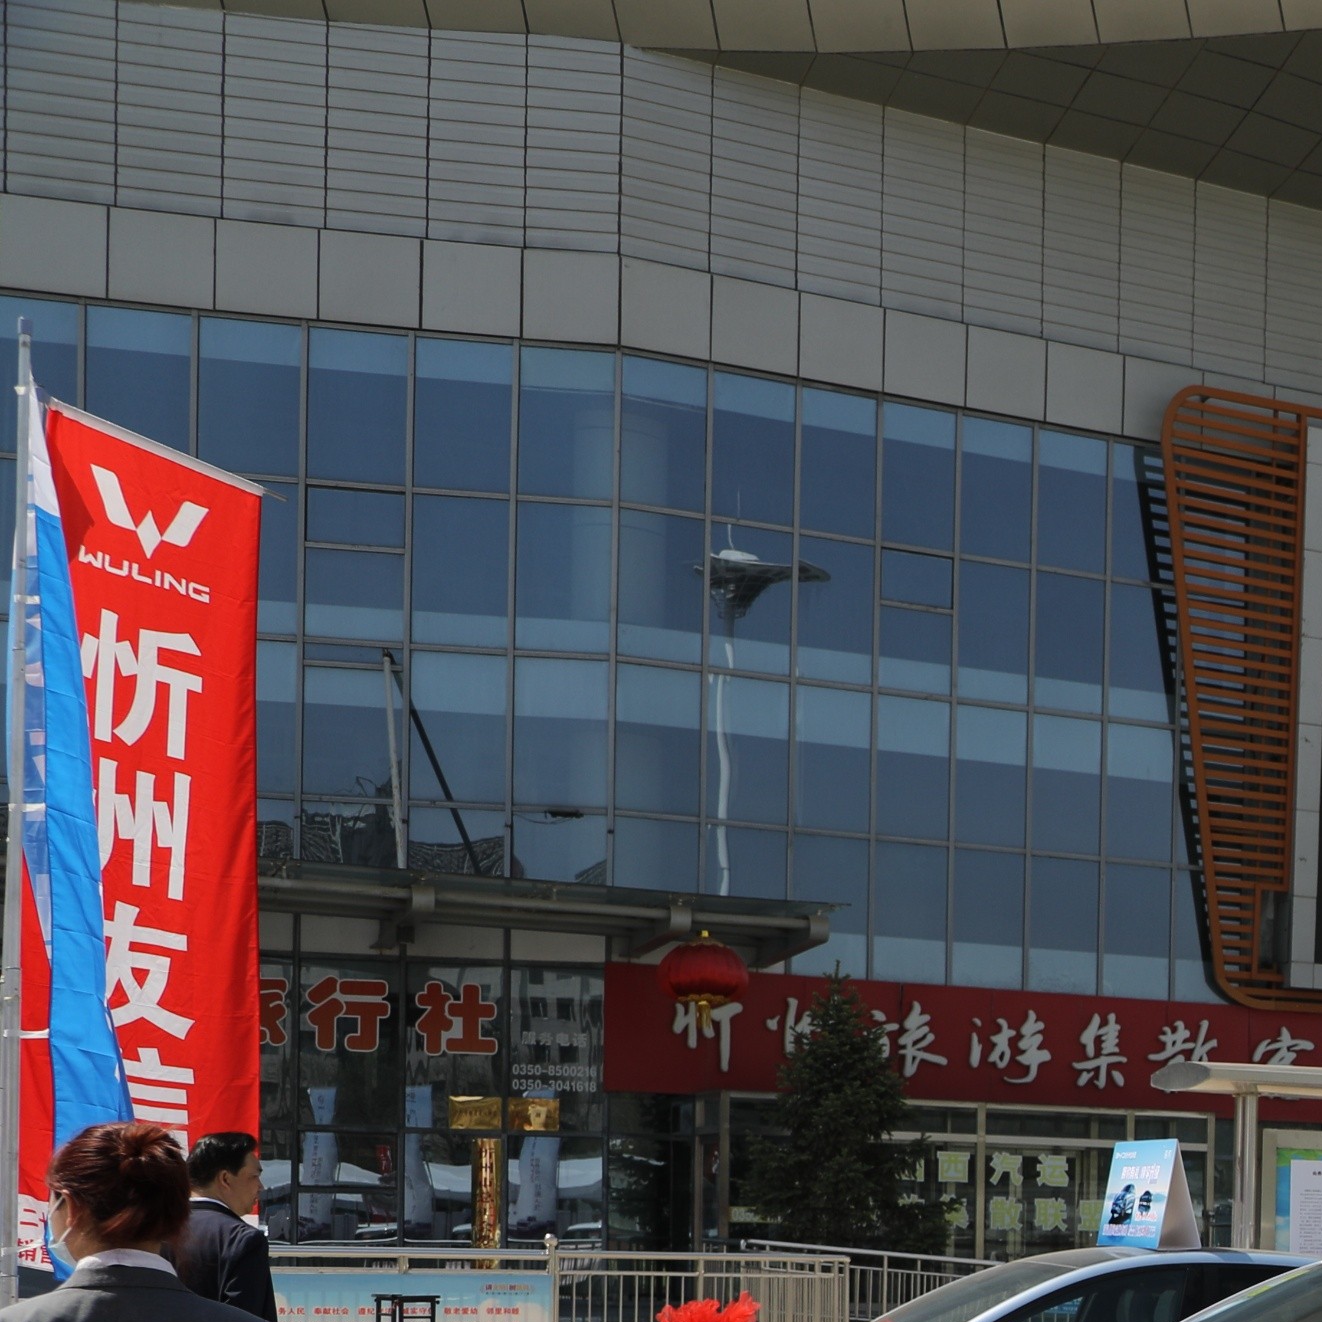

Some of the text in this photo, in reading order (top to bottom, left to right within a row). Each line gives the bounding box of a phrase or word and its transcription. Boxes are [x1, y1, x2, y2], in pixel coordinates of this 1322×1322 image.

[78, 545, 211, 603] WULING
[521, 1031, 589, 1048] 服务电话
